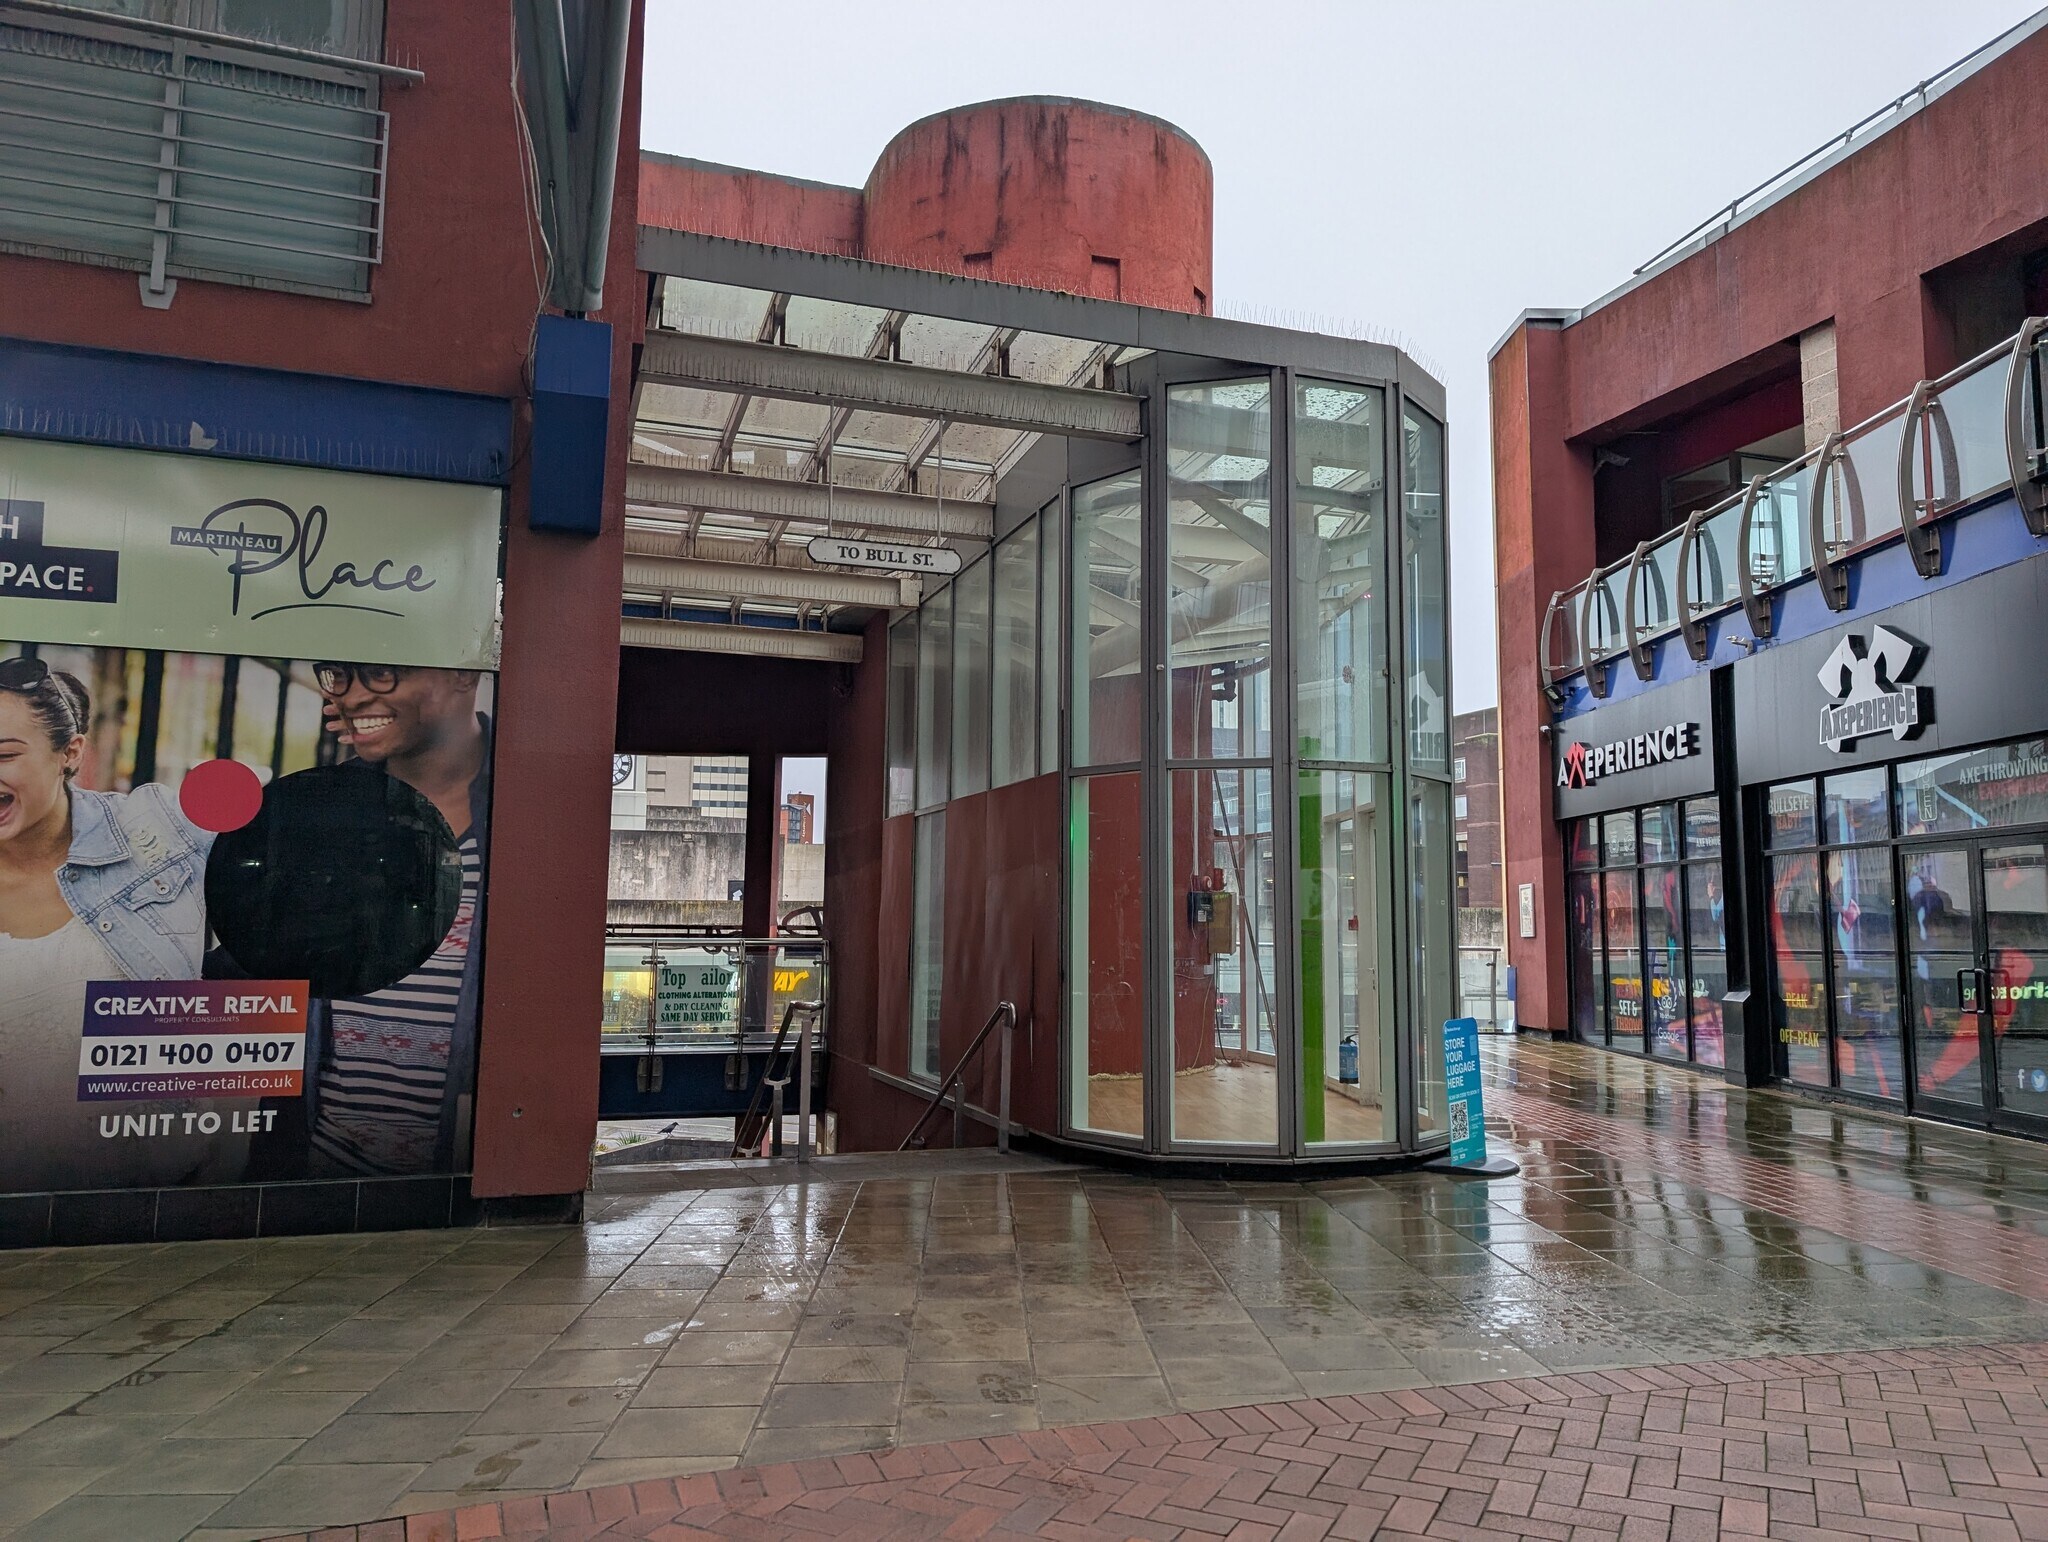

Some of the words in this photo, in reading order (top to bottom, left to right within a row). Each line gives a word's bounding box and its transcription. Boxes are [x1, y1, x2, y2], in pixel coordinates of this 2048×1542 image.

[176, 530, 278, 551] MARTINEAU
[201, 498, 437, 616] Place
[837, 545, 860, 559] TO
[866, 549, 907, 564] BULL
[912, 553, 934, 567] ST.
[1820, 687, 1917, 743] AXEPERIENCE
[1557, 722, 1689, 790] AXEPERIENCE
[1959, 765, 1981, 785] AXE
[1983, 756, 2048, 782] THROWING
[1768, 794, 1809, 815] BULLSEYE
[662, 968, 686, 989] Top
[701, 968, 732, 986] ailor
[774, 970, 809, 991] AY
[658, 991, 692, 999] CLOTHING
[1785, 992, 1808, 1008] PEAK
[94, 996, 210, 1016] CREATIVE
[224, 995, 298, 1014] RETAIL
[664, 1002, 671, 1011] &
[673, 1002, 688, 1011] DRY
[690, 1002, 729, 1011] CLEANING
[1618, 1000, 1631, 1016] SET
[1631, 1001, 1638, 1017] &
[154, 1016, 190, 1024] PROPERTY
[191, 1015, 240, 1023] CONSULTANTS
[661, 1012, 681, 1022] SAME
[683, 1012, 699, 1022] DAY
[701, 1011, 732, 1022] SERVICE
[1445, 1037, 1465, 1051] STORE
[1658, 1026, 1680, 1043] Google
[1780, 1028, 1819, 1047] OFF-PEAK
[91, 1044, 147, 1067] 0121
[159, 1042, 213, 1065] 400
[225, 1041, 296, 1064] 0407
[1445, 1051, 1463, 1063] YOUR
[1446, 1061, 1476, 1076] LUGGAGE
[88, 1074, 293, 1094] www.creative-retail.co.uk
[1447, 1076, 1464, 1089] HERE
[100, 1113, 174, 1138] UNIT
[182, 1112, 221, 1135] TO
[231, 1110, 278, 1134] LET
